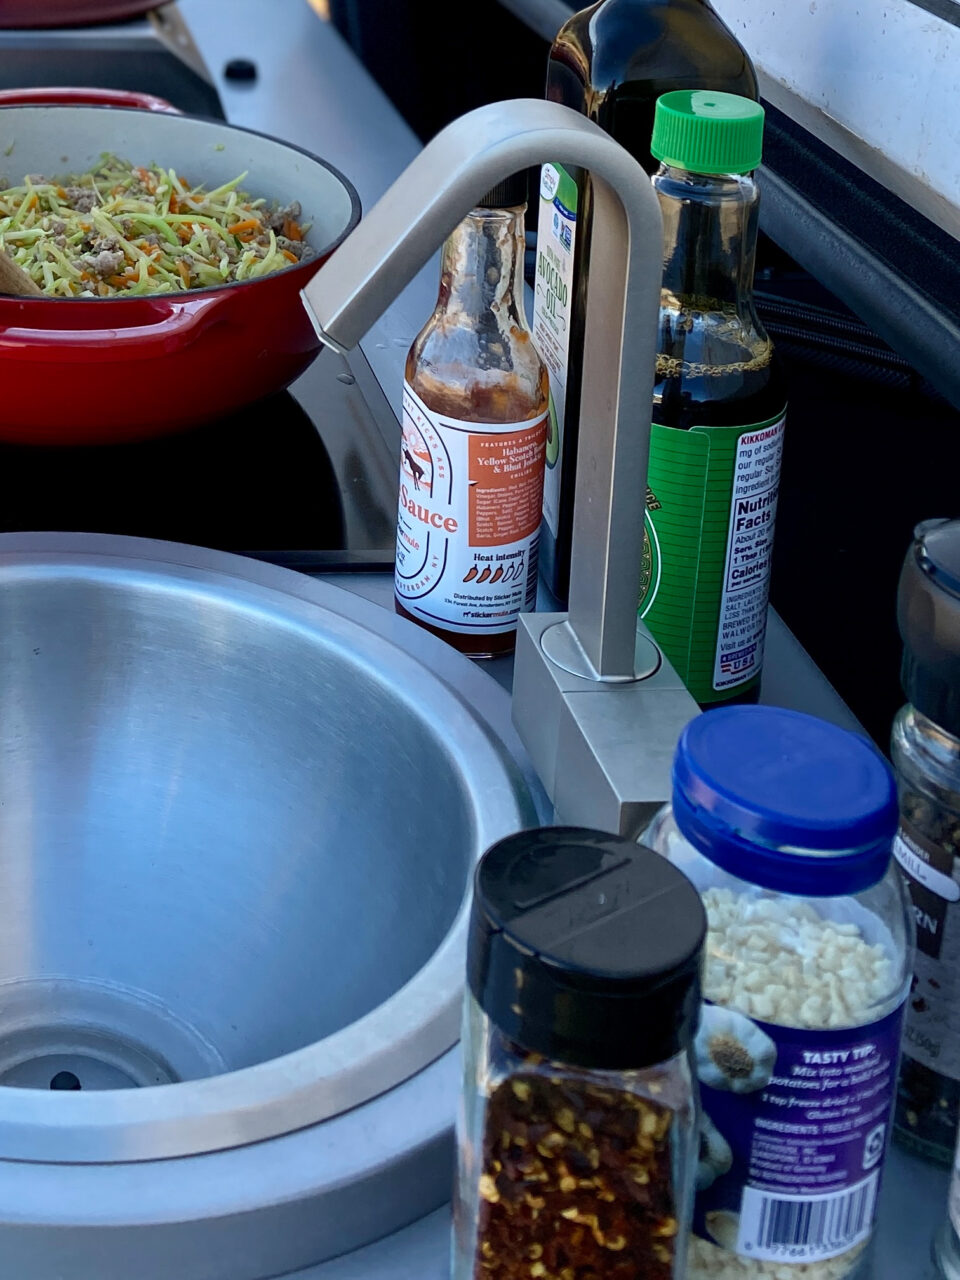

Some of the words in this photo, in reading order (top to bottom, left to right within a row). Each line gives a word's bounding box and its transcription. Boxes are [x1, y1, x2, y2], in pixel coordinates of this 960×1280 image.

[537, 251, 568, 308] AVOCADO
[545, 288, 556, 320] OIL
[480, 440, 516, 448] FEATURES
[477, 457, 507, 466] Yellow
[509, 450, 534, 463] Scotch
[739, 449, 753, 459] mg
[754, 445, 762, 455] of
[493, 465, 501, 474] &
[503, 462, 522, 473] Bhut
[738, 461, 752, 470] our
[736, 469, 764, 483] regular
[735, 477, 770, 495] ingredient
[401, 483, 459, 533] Sauce
[736, 510, 771, 532] Facts
[735, 532, 757, 545] About
[473, 553, 493, 562] Heat
[495, 549, 526, 561] intensity
[731, 559, 768, 580] Calories
[453, 592, 486, 601] Distributed
[493, 593, 512, 601] Sticker
[722, 616, 751, 631] BREWED
[720, 640, 736, 651] Visit
[733, 653, 755, 670] USA
[803, 1050, 851, 1064] TASTY
[852, 1044, 877, 1060] TIP:
[792, 1065, 818, 1077] Mix
[767, 1076, 821, 1090] potatoes
[821, 1078, 840, 1092] for
